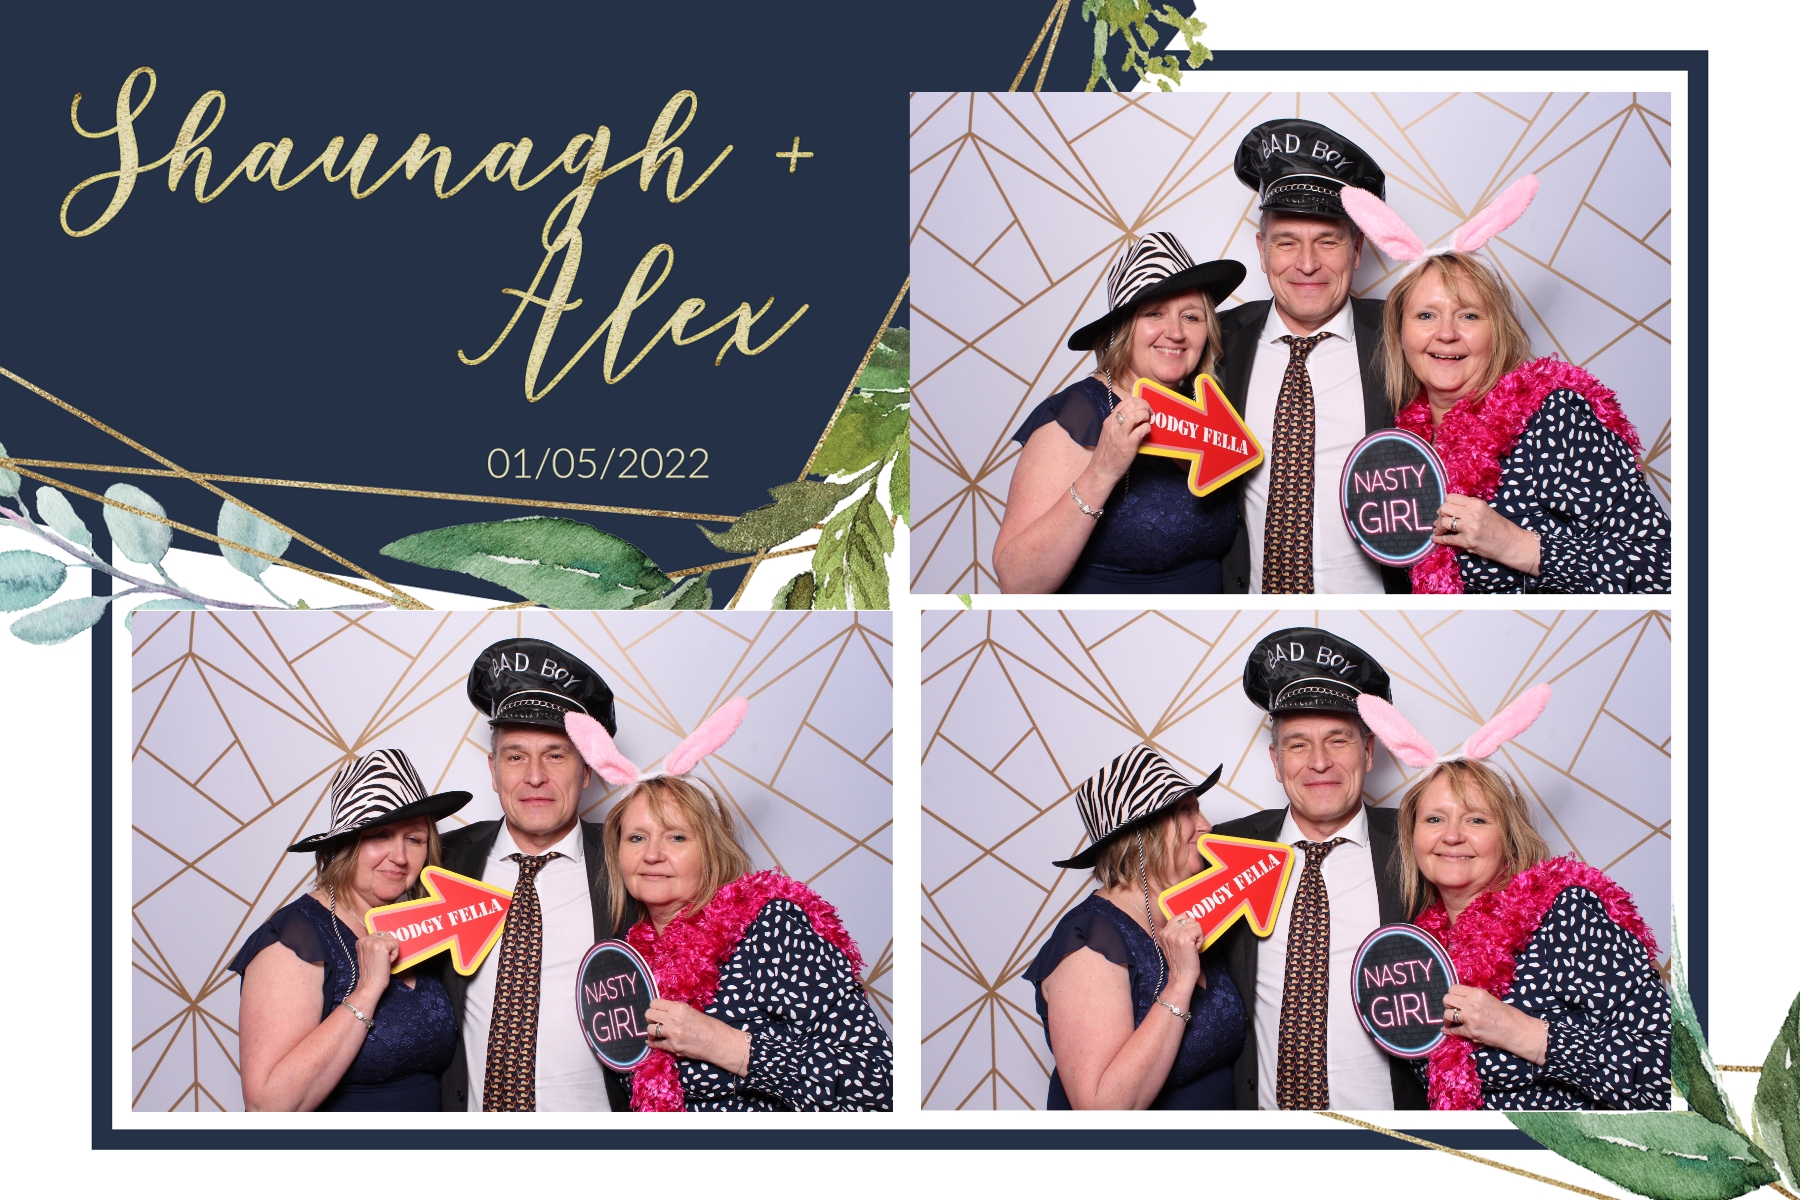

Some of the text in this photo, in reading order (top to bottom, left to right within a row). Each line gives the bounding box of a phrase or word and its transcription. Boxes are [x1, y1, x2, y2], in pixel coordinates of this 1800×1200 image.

[1261, 133, 1354, 170] BAD BOY
[1203, 426, 1249, 456] FELLA
[1354, 464, 1426, 494] NASTY
[1359, 498, 1433, 533] GIRL
[492, 652, 582, 689] BAD BOY
[1267, 642, 1358, 675] BAD BOY
[1232, 853, 1281, 892] FELLA
[447, 898, 503, 926] FELLA
[584, 971, 637, 1005] NASTY
[1363, 958, 1433, 989] NASTY
[592, 1005, 648, 1042] GIRL
[1371, 991, 1443, 1027] GIRL
